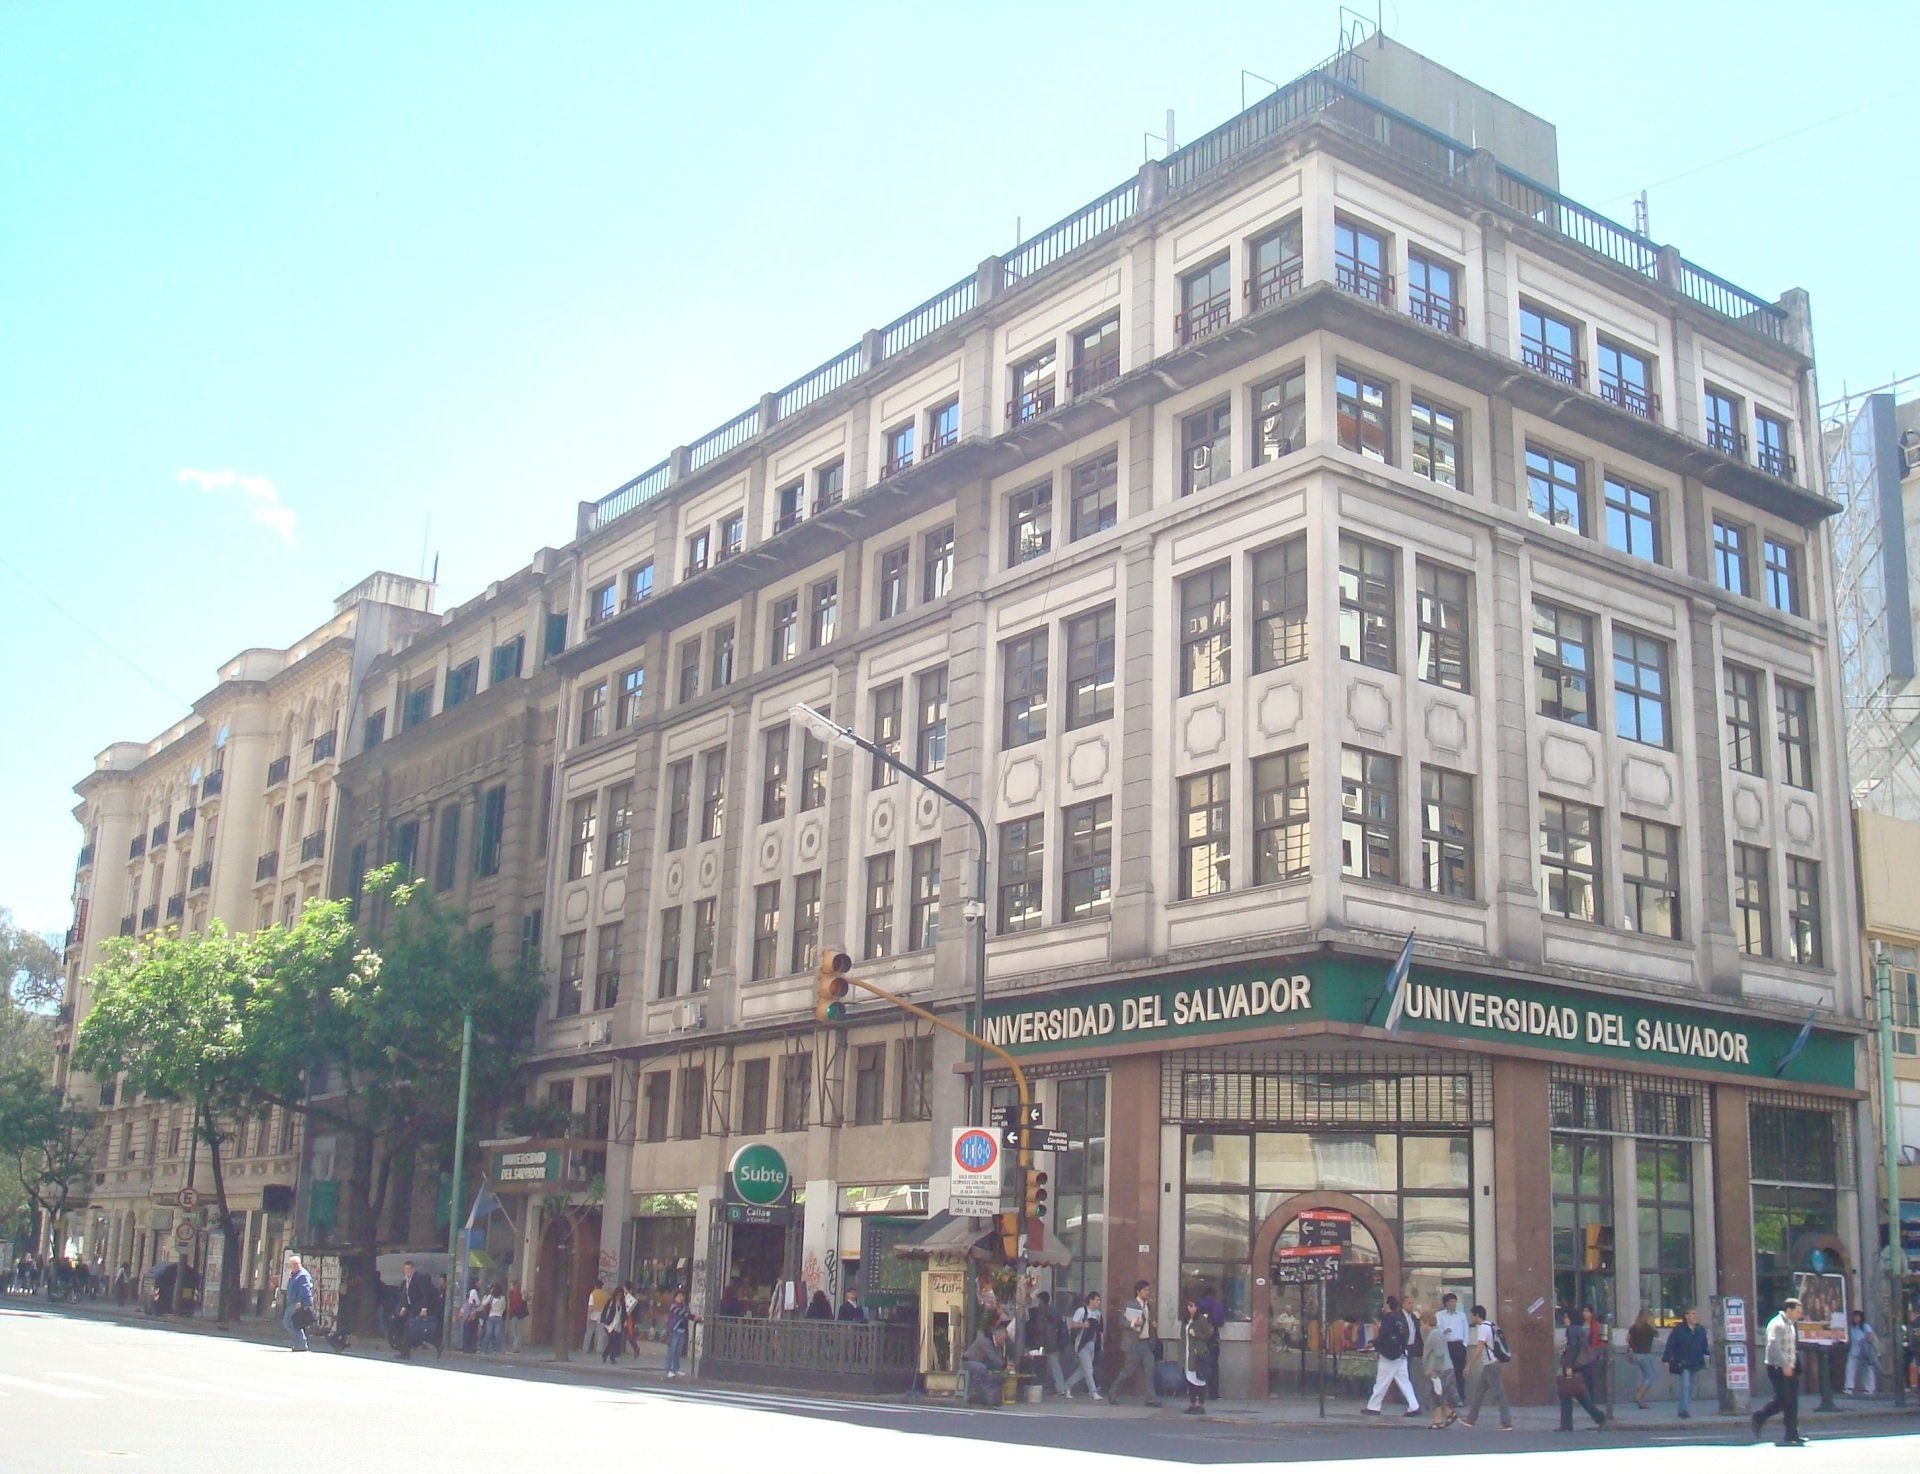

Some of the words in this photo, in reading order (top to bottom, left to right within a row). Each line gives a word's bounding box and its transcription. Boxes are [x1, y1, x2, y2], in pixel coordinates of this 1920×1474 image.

[1122, 995, 1168, 1030] DEL
[1173, 975, 1312, 1025] SALVADOR
[1405, 982, 1579, 1041] UNIVERSIDAD
[1585, 1011, 1630, 1048] DEL
[1635, 1018, 1750, 1065] SALVADOR
[740, 1165, 785, 1183] Subte
[732, 1209, 739, 1218] D
[746, 1208, 771, 1217] Callao
